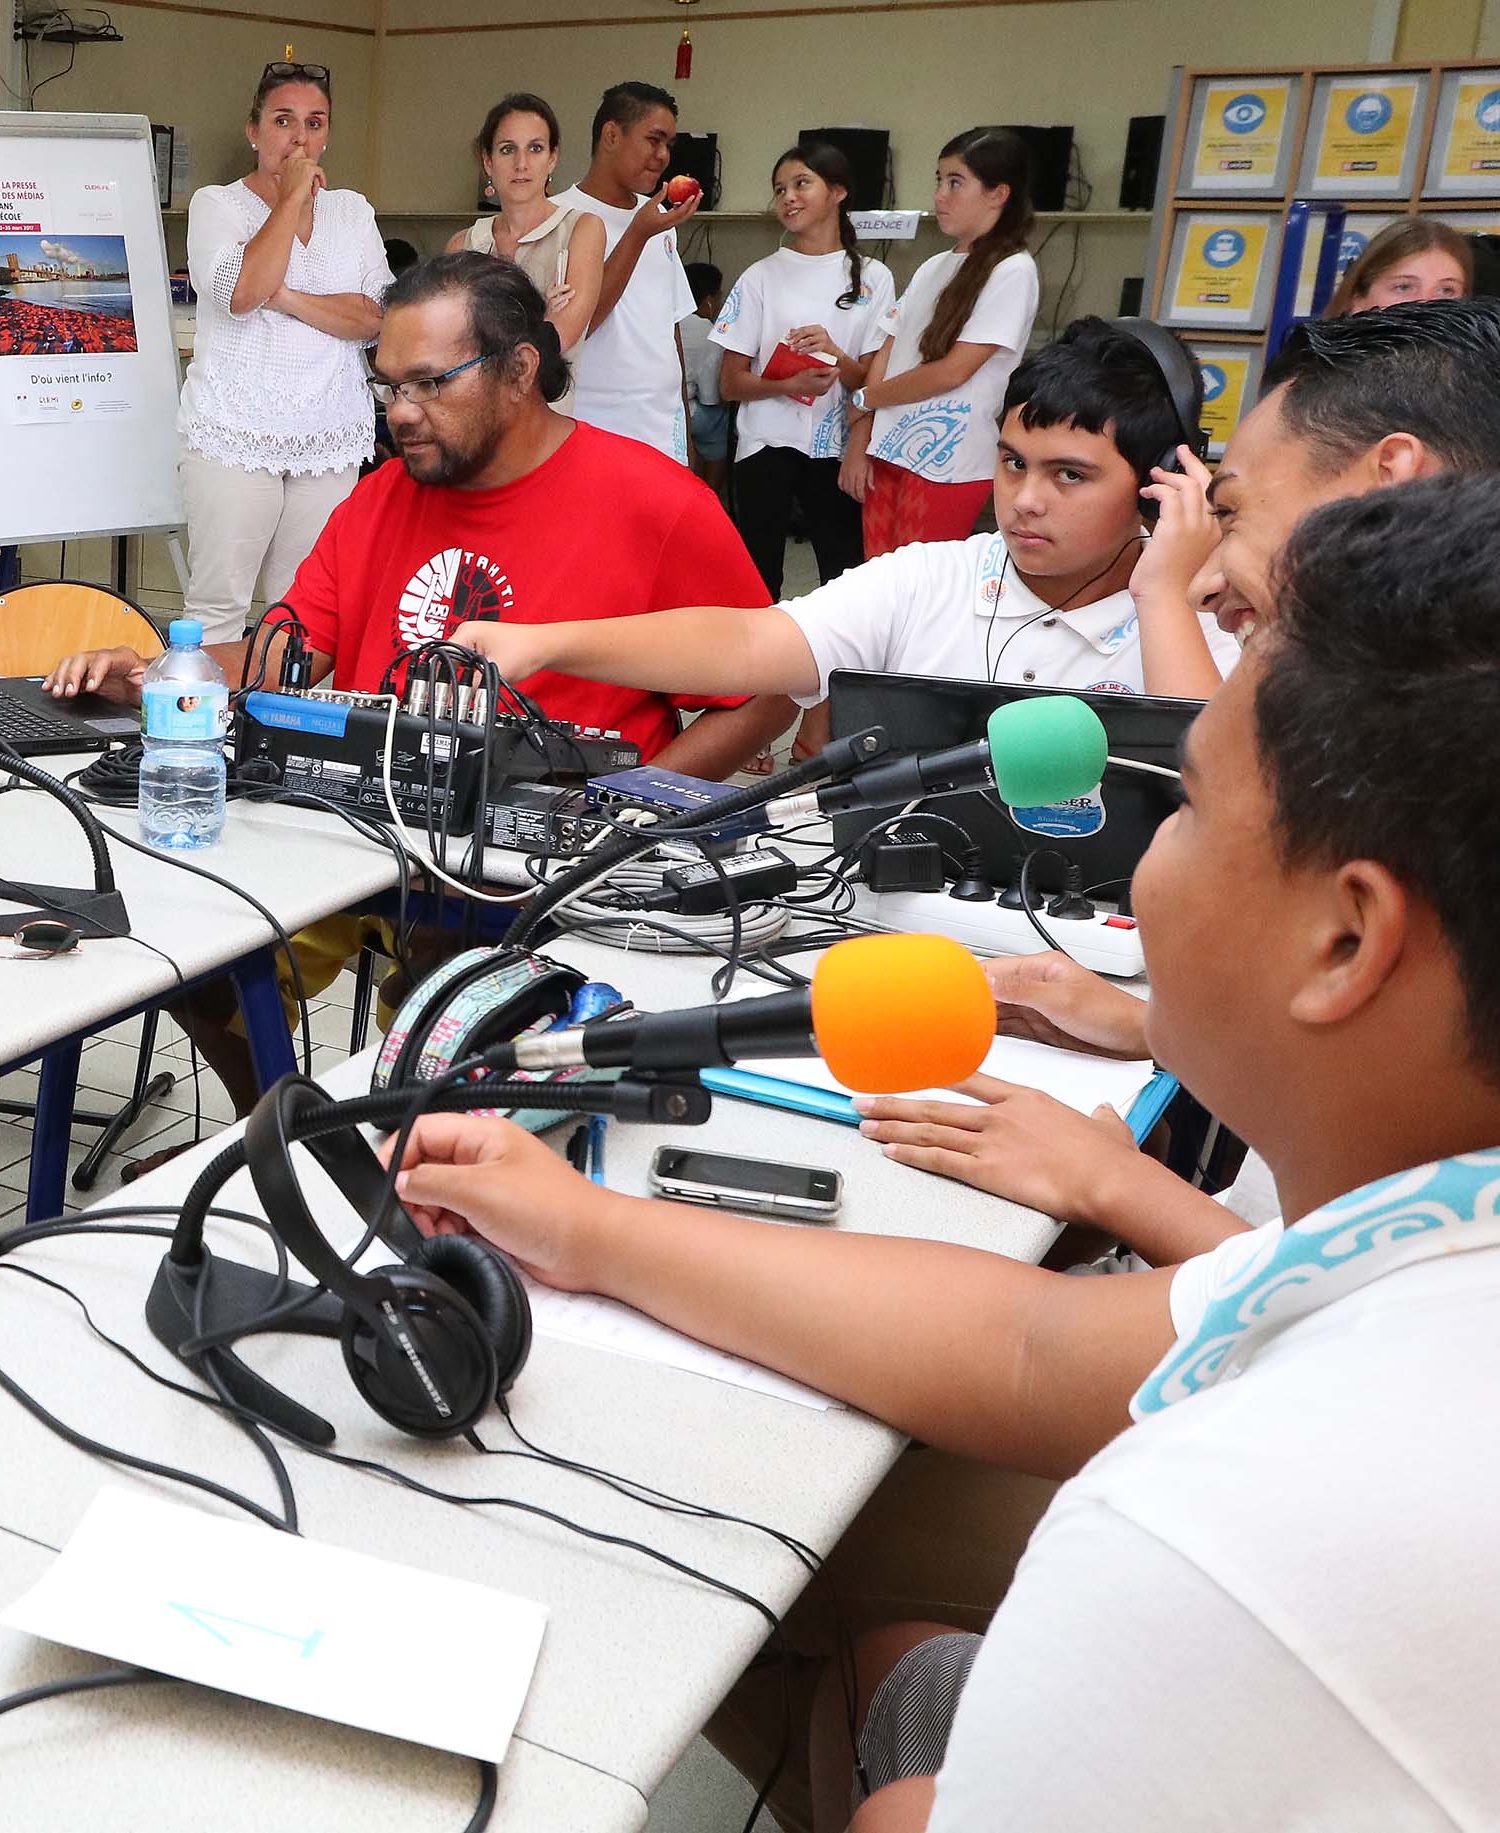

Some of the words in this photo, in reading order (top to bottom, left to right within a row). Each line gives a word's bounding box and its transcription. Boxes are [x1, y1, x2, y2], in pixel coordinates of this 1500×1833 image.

[12, 181, 37, 189] PRESSE
[17, 190, 45, 200] MÉDIAS
[855, 220, 903, 230] SILENCE
[31, 374, 53, 385] D'où
[55, 374, 80, 384] vient
[463, 552, 514, 608] TAHITI
[271, 712, 301, 726] YAMAHA
[617, 751, 638, 766] YAMAHA
[649, 781, 712, 799] NETGEAR
